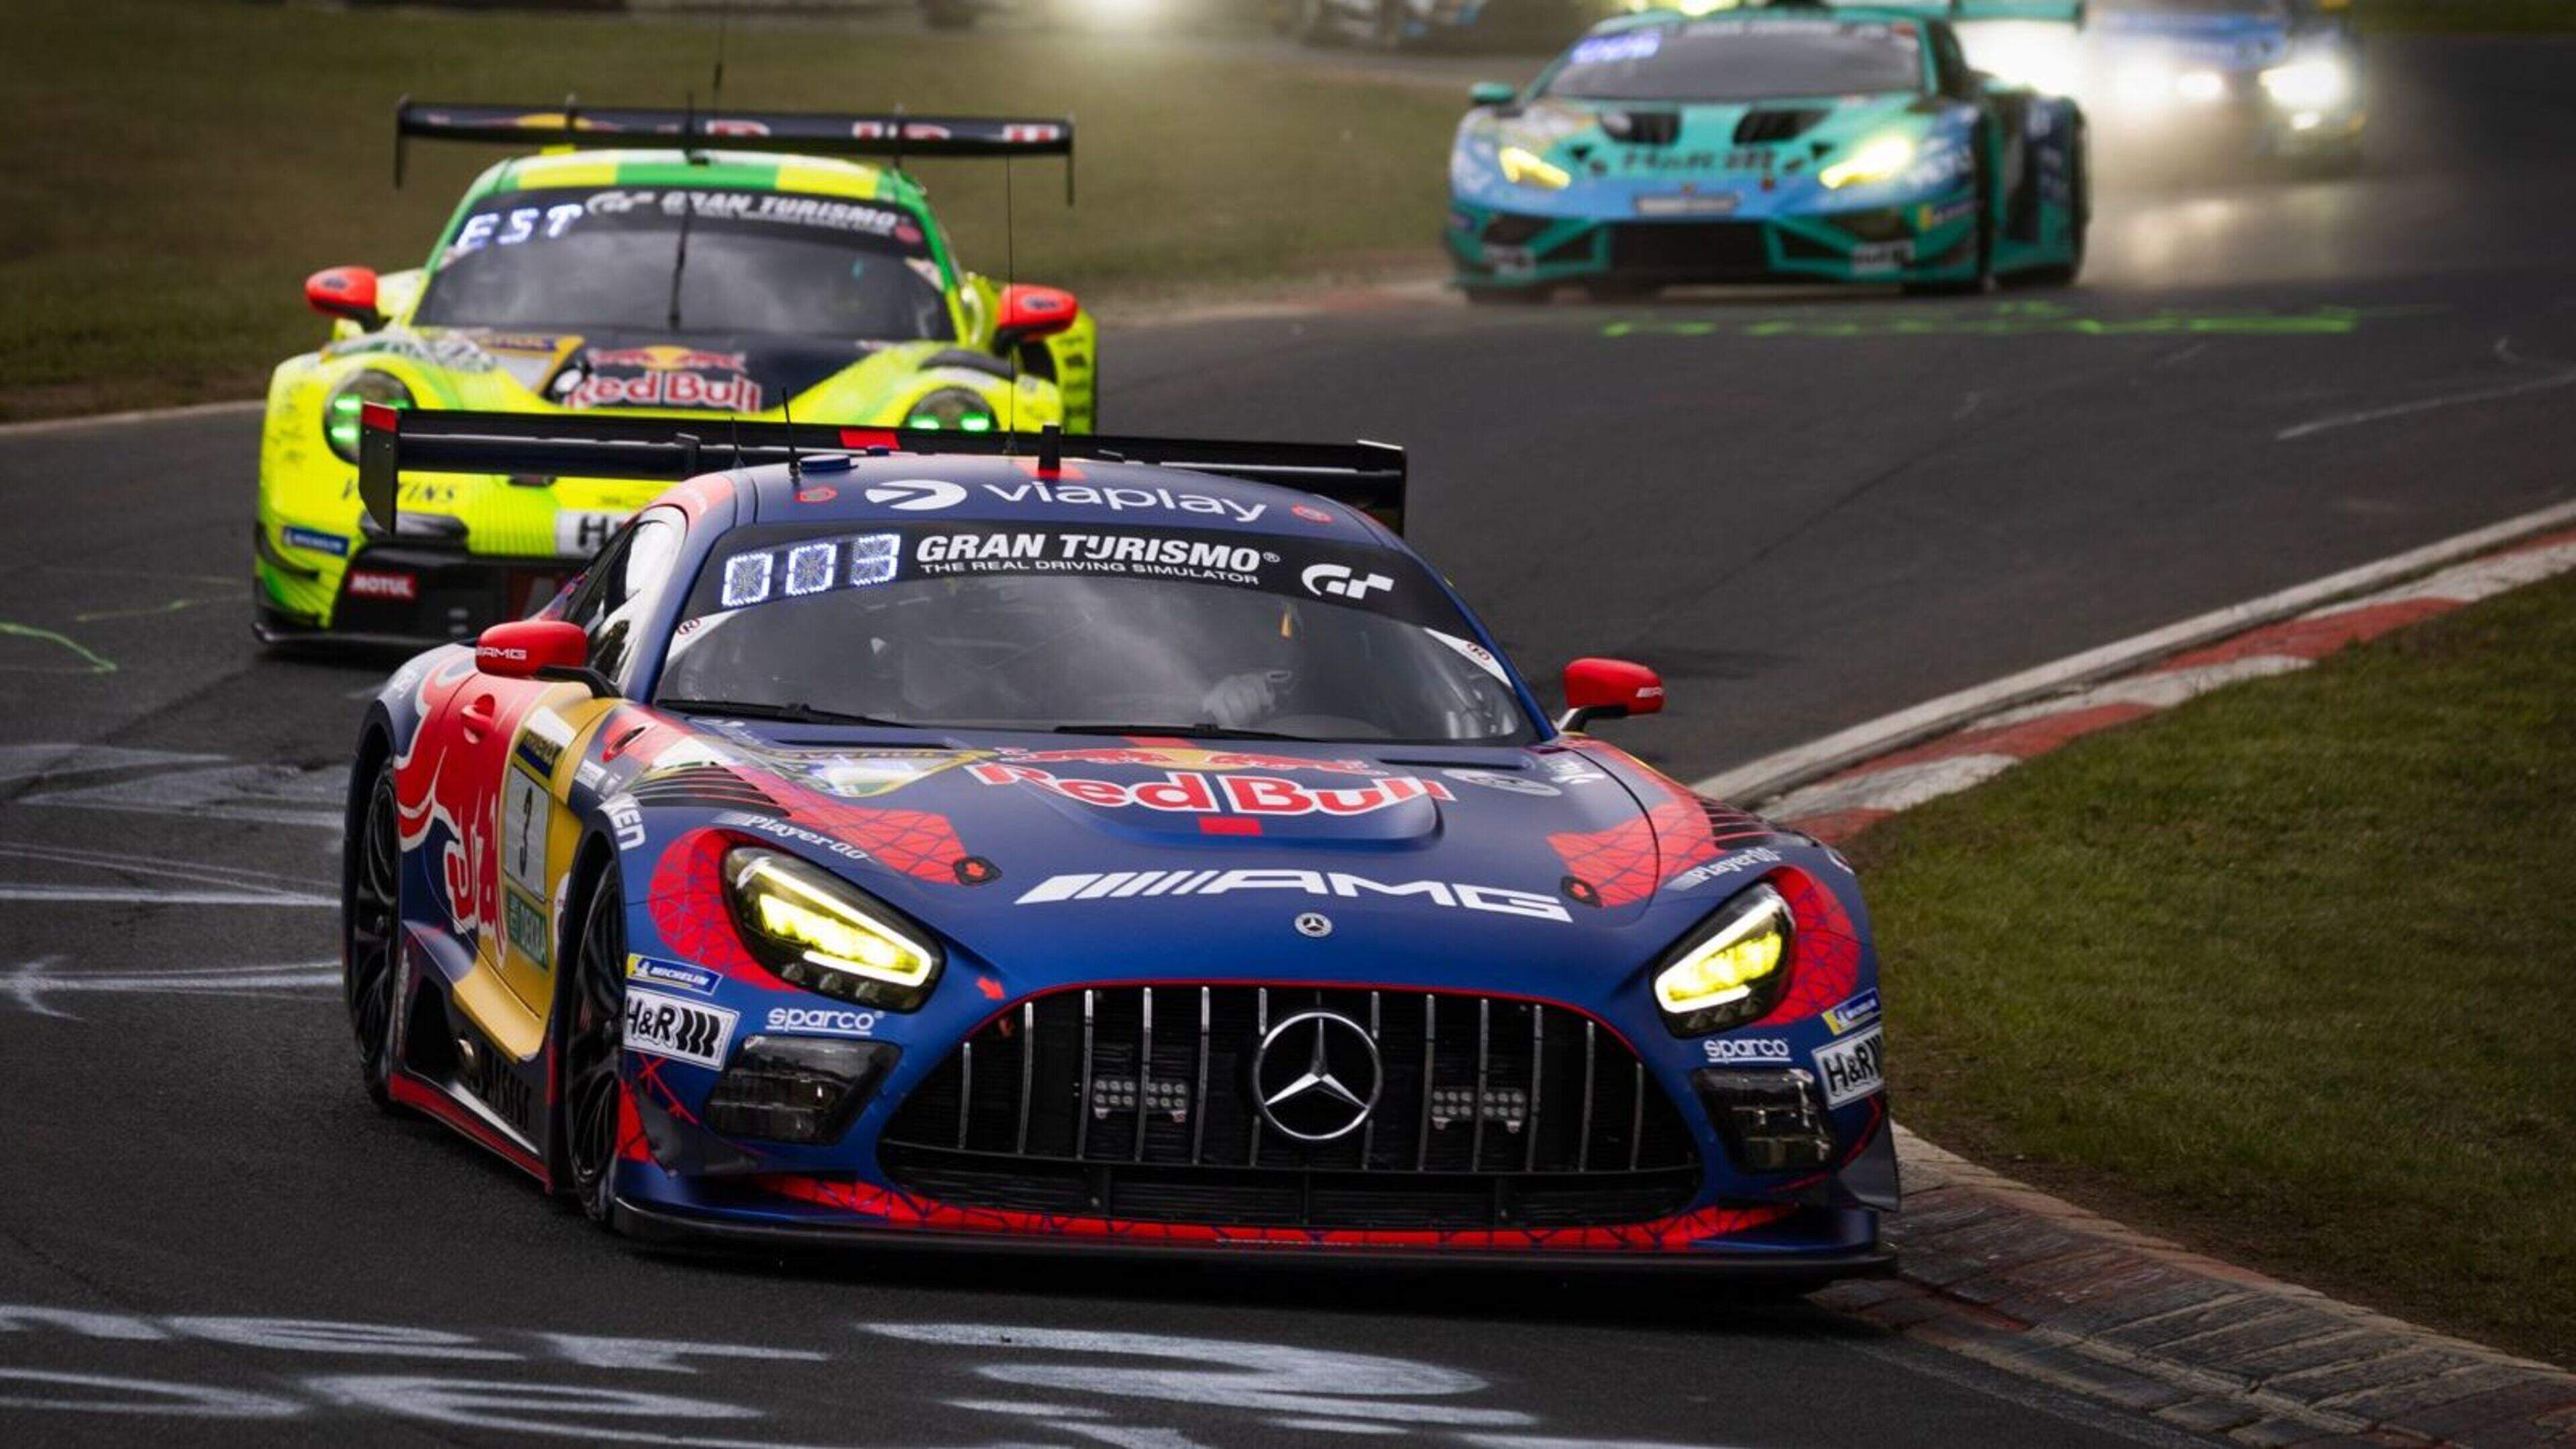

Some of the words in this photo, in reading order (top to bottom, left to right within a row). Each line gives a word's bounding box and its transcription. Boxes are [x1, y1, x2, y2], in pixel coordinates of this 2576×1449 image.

[663, 370, 762, 413] Bull
[981, 480, 1267, 523] viaplay
[916, 534, 1046, 562] GRAN
[352, 573, 415, 598] MOTUL
[721, 534, 901, 606] 003
[920, 564, 966, 574] THE
[971, 561, 1030, 571] REAL
[1035, 561, 1126, 572] DRIVING
[1132, 564, 1259, 586] SIMULATOR
[482, 646, 527, 661] AMG
[965, 763, 1220, 813] Red
[1216, 774, 1456, 816] Bull
[1197, 869, 1573, 923] AMG
[627, 997, 676, 1041] H&R
[767, 1008, 874, 1032] sparco
[1703, 1039, 1789, 1065] sparco
[1823, 1043, 1874, 1092] H&R
